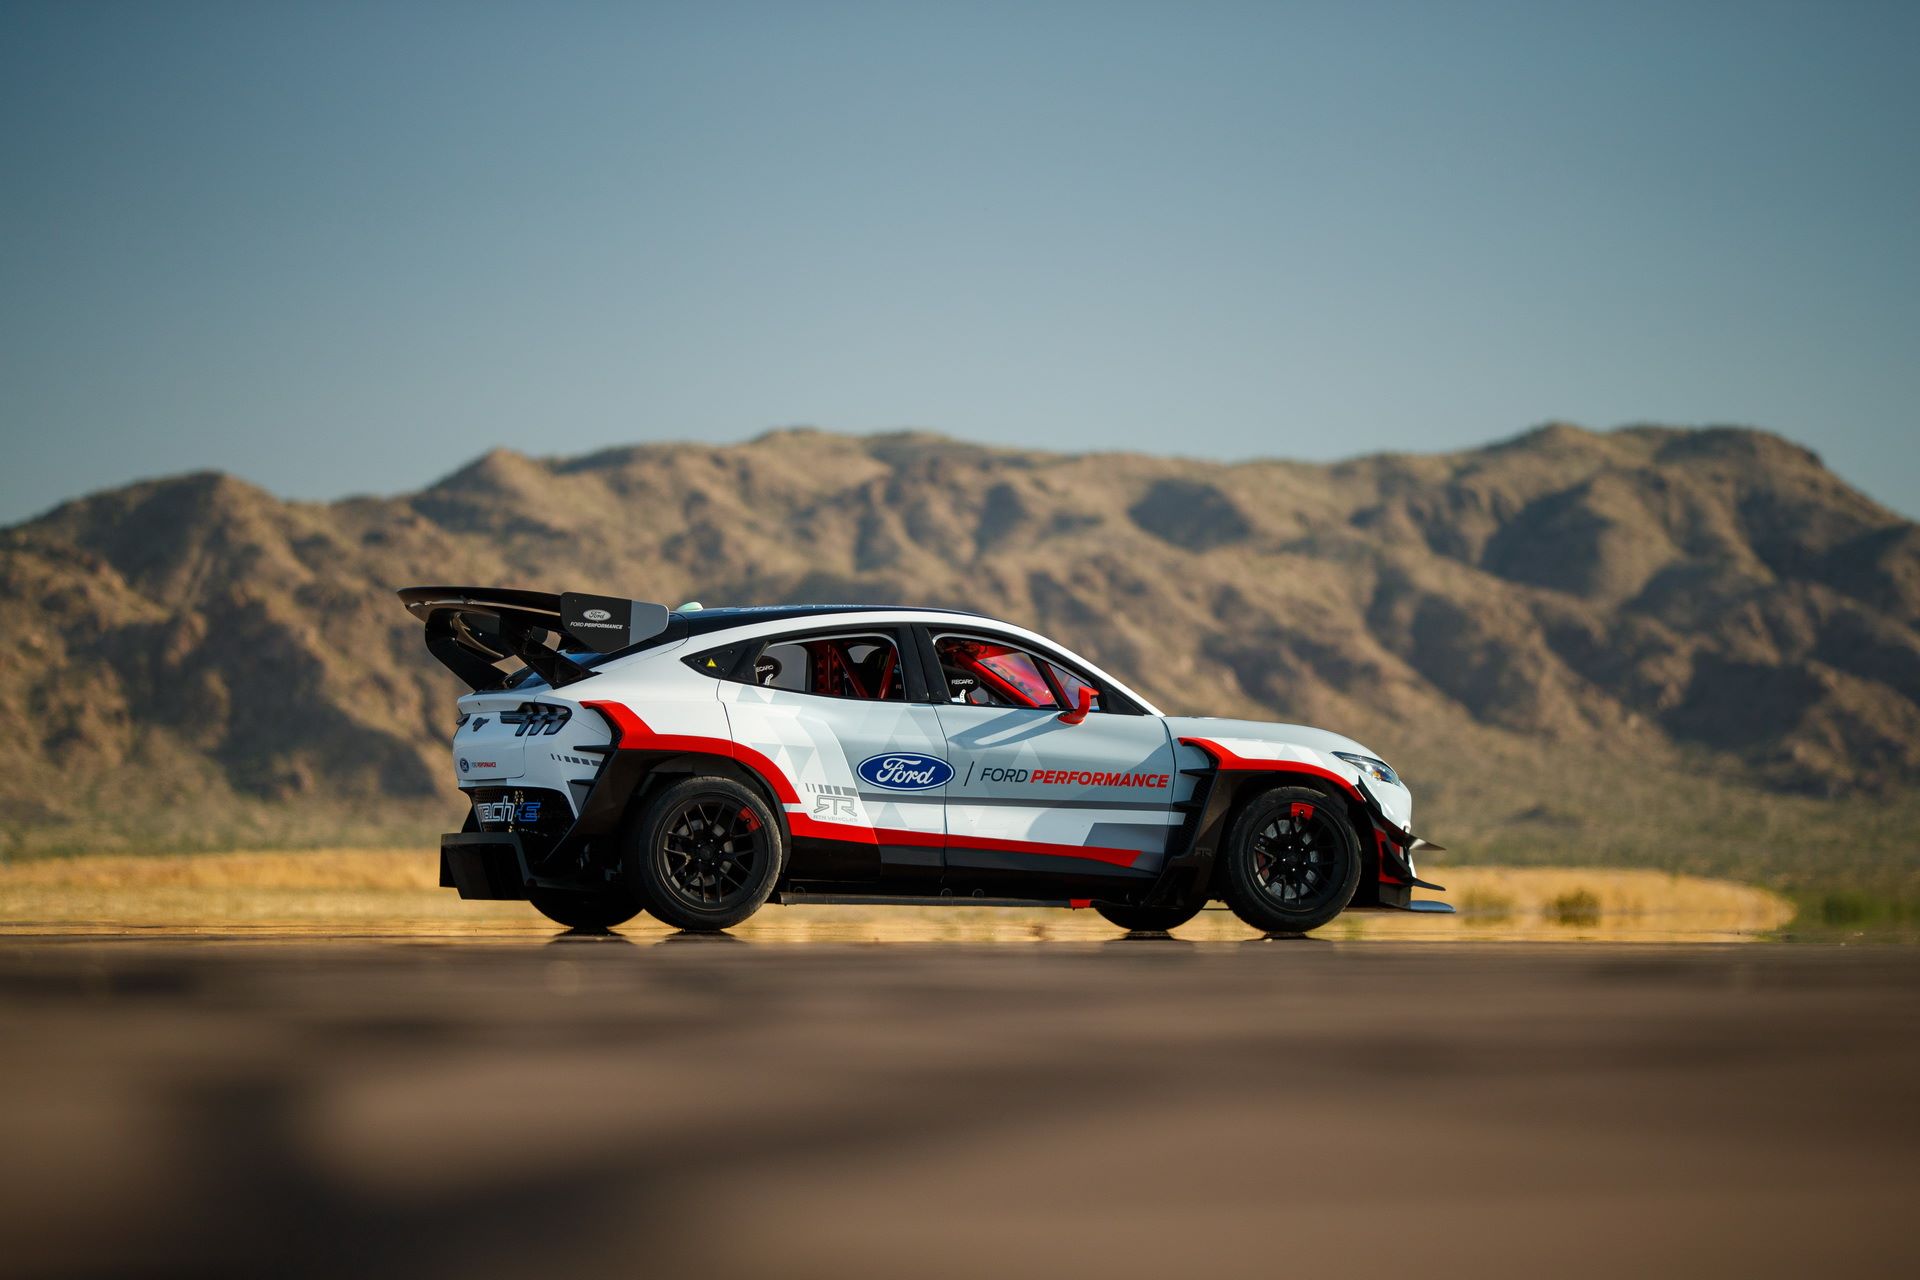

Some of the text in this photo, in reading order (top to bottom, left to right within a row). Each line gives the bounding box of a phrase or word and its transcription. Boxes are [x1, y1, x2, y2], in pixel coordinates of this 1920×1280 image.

[588, 611, 606, 619] Ford
[756, 665, 774, 673] ECARO
[876, 757, 936, 785] Ford
[980, 767, 1170, 789] FORD PERFORMANCE
